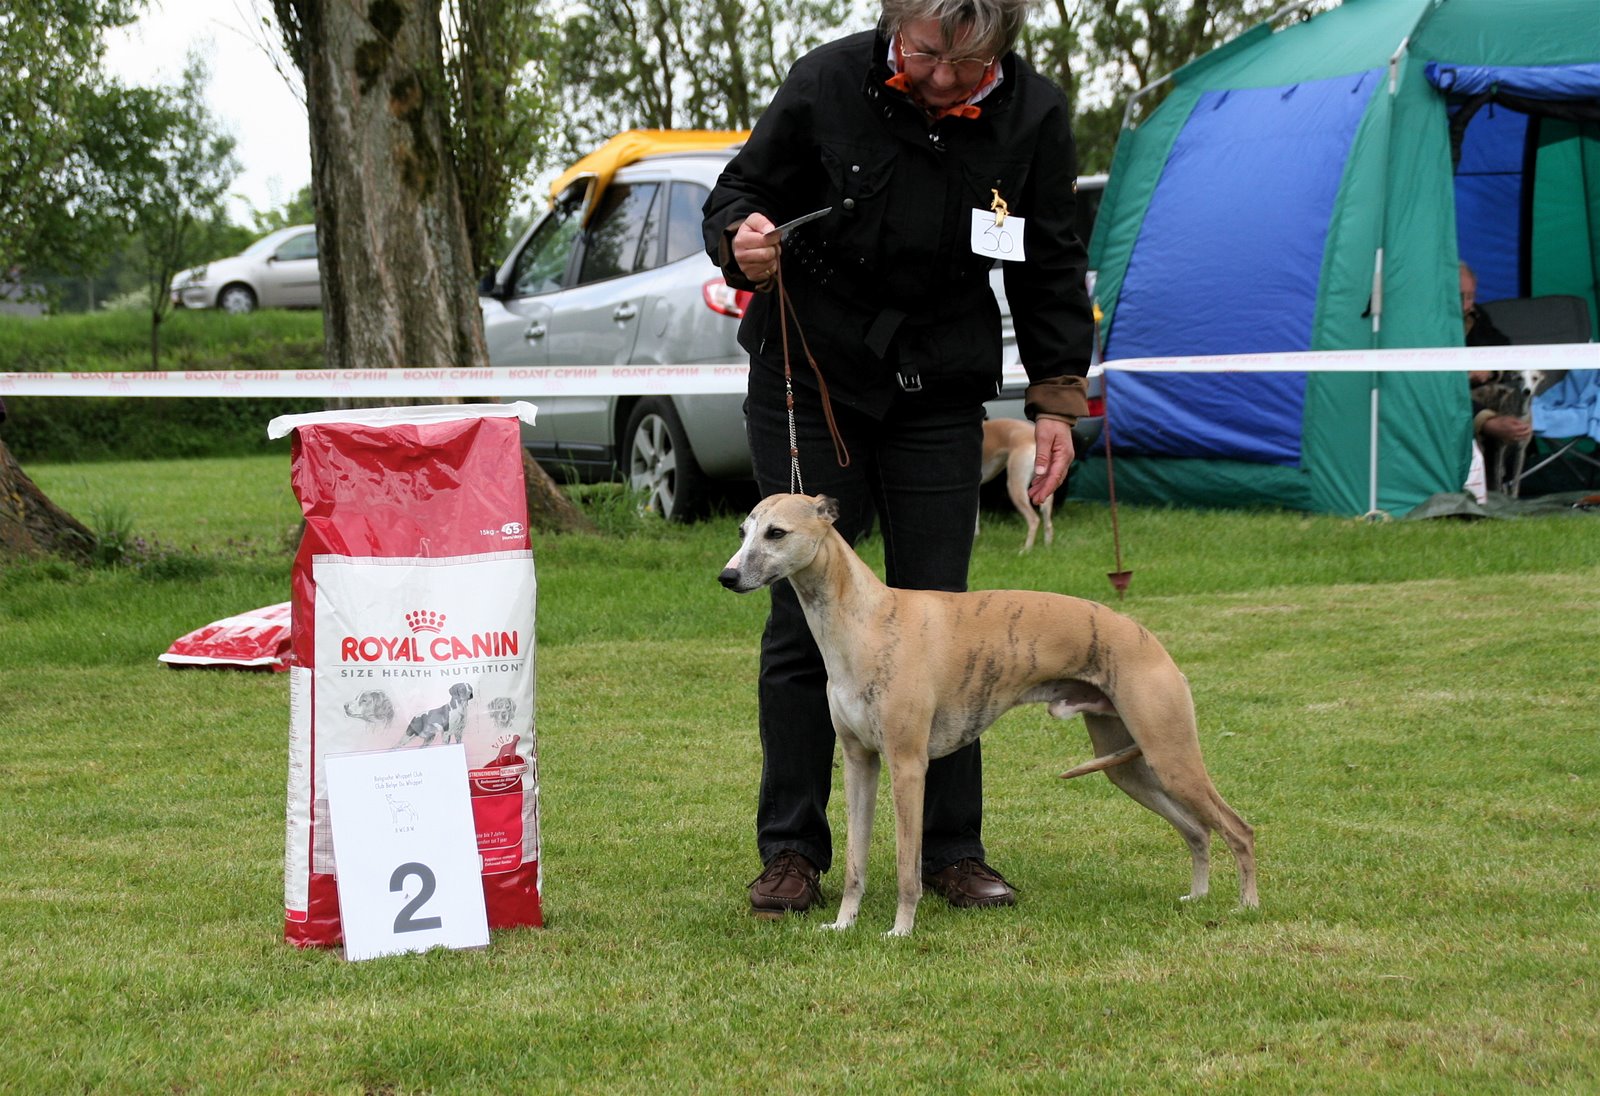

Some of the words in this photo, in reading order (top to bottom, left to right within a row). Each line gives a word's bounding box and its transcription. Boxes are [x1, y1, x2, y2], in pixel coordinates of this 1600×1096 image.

[982, 218, 1014, 253] 30
[505, 524, 520, 535] 65
[341, 636, 425, 663] ROYAL
[430, 630, 519, 661] CANIN
[341, 669, 374, 678] SIZE
[382, 669, 432, 678] HEALTH
[389, 861, 442, 934] 2
